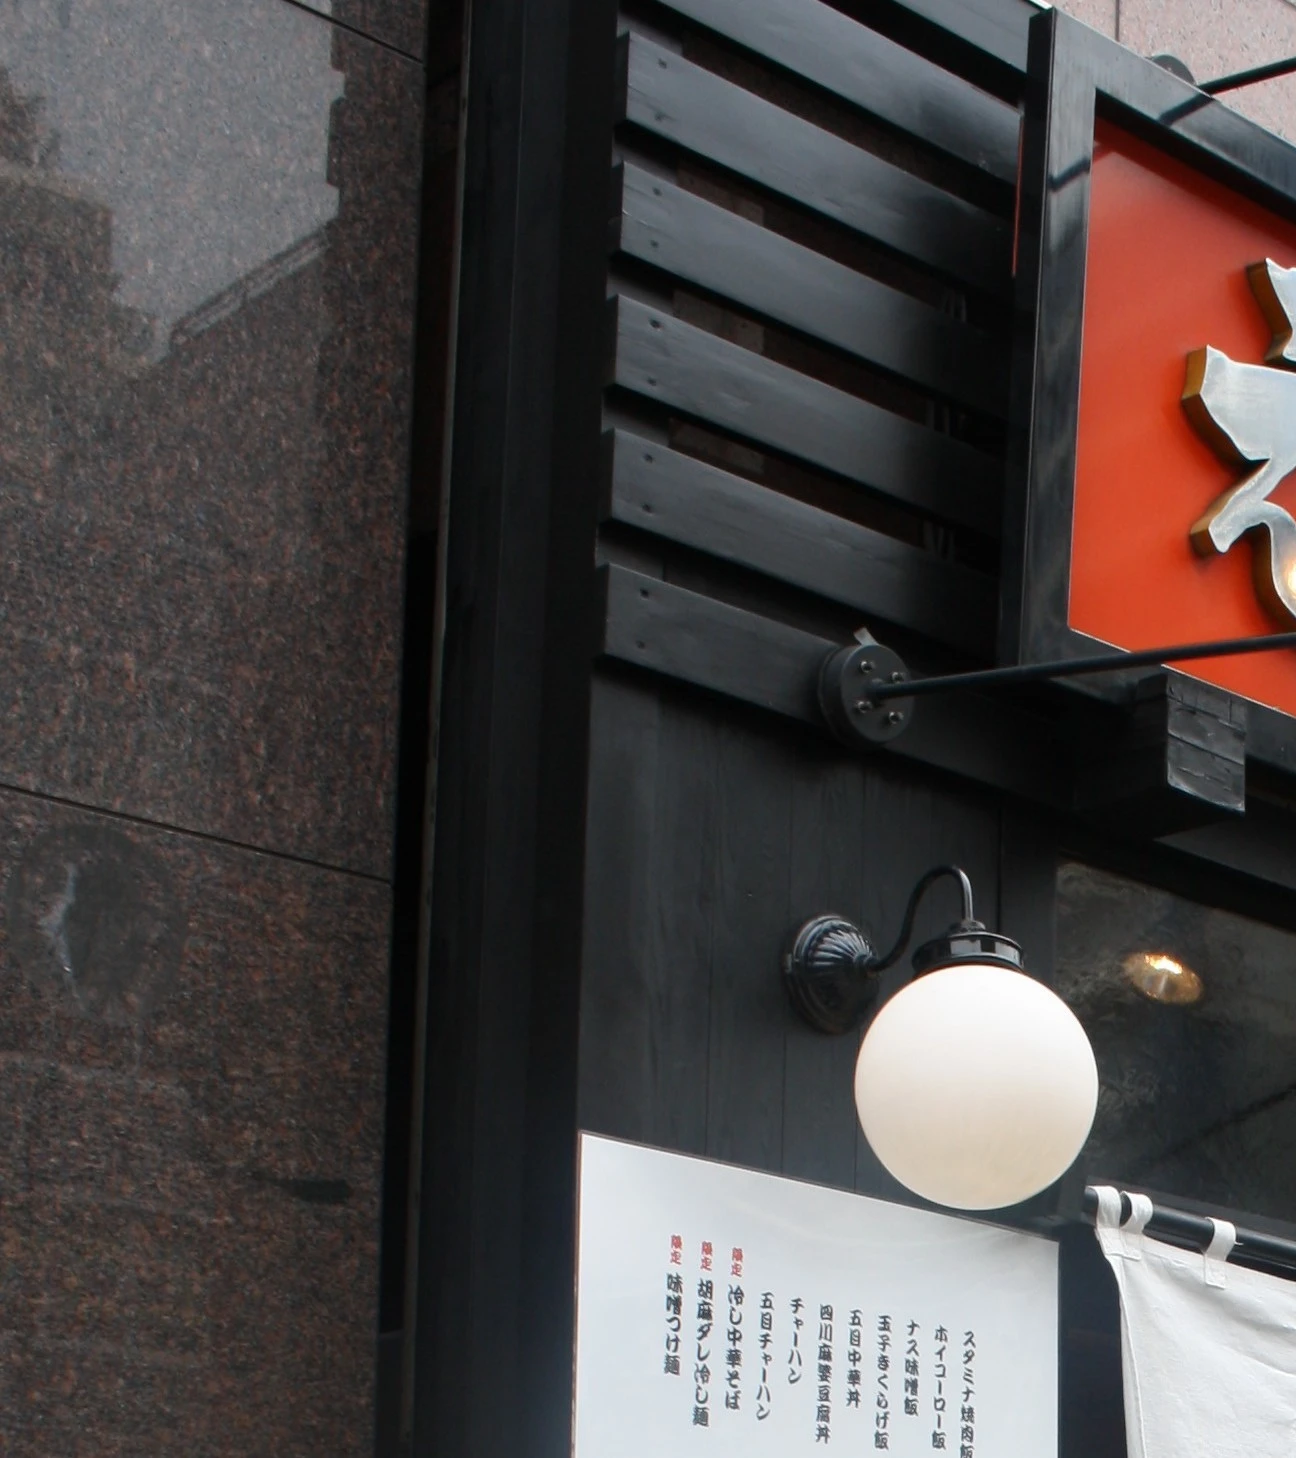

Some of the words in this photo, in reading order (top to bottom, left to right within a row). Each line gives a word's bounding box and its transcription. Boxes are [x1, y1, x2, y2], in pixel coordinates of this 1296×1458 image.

[671, 1235, 682, 1264] 限定
[701, 1241, 712, 1271] 限定
[731, 1248, 743, 1277] 限定
[664, 1273, 683, 1375] 味噌つけ麺
[725, 1285, 744, 1410] 冷し中華そば
[756, 1292, 774, 1420] 五目チャーハン
[788, 1298, 804, 1384] チャーハン
[847, 1310, 862, 1408] 五目中華丼
[904, 1320, 920, 1416] ナス味噌飯
[816, 1304, 833, 1444] 四川麻婆豆腐丼
[932, 1325, 947, 1449] ホイコーロー飯
